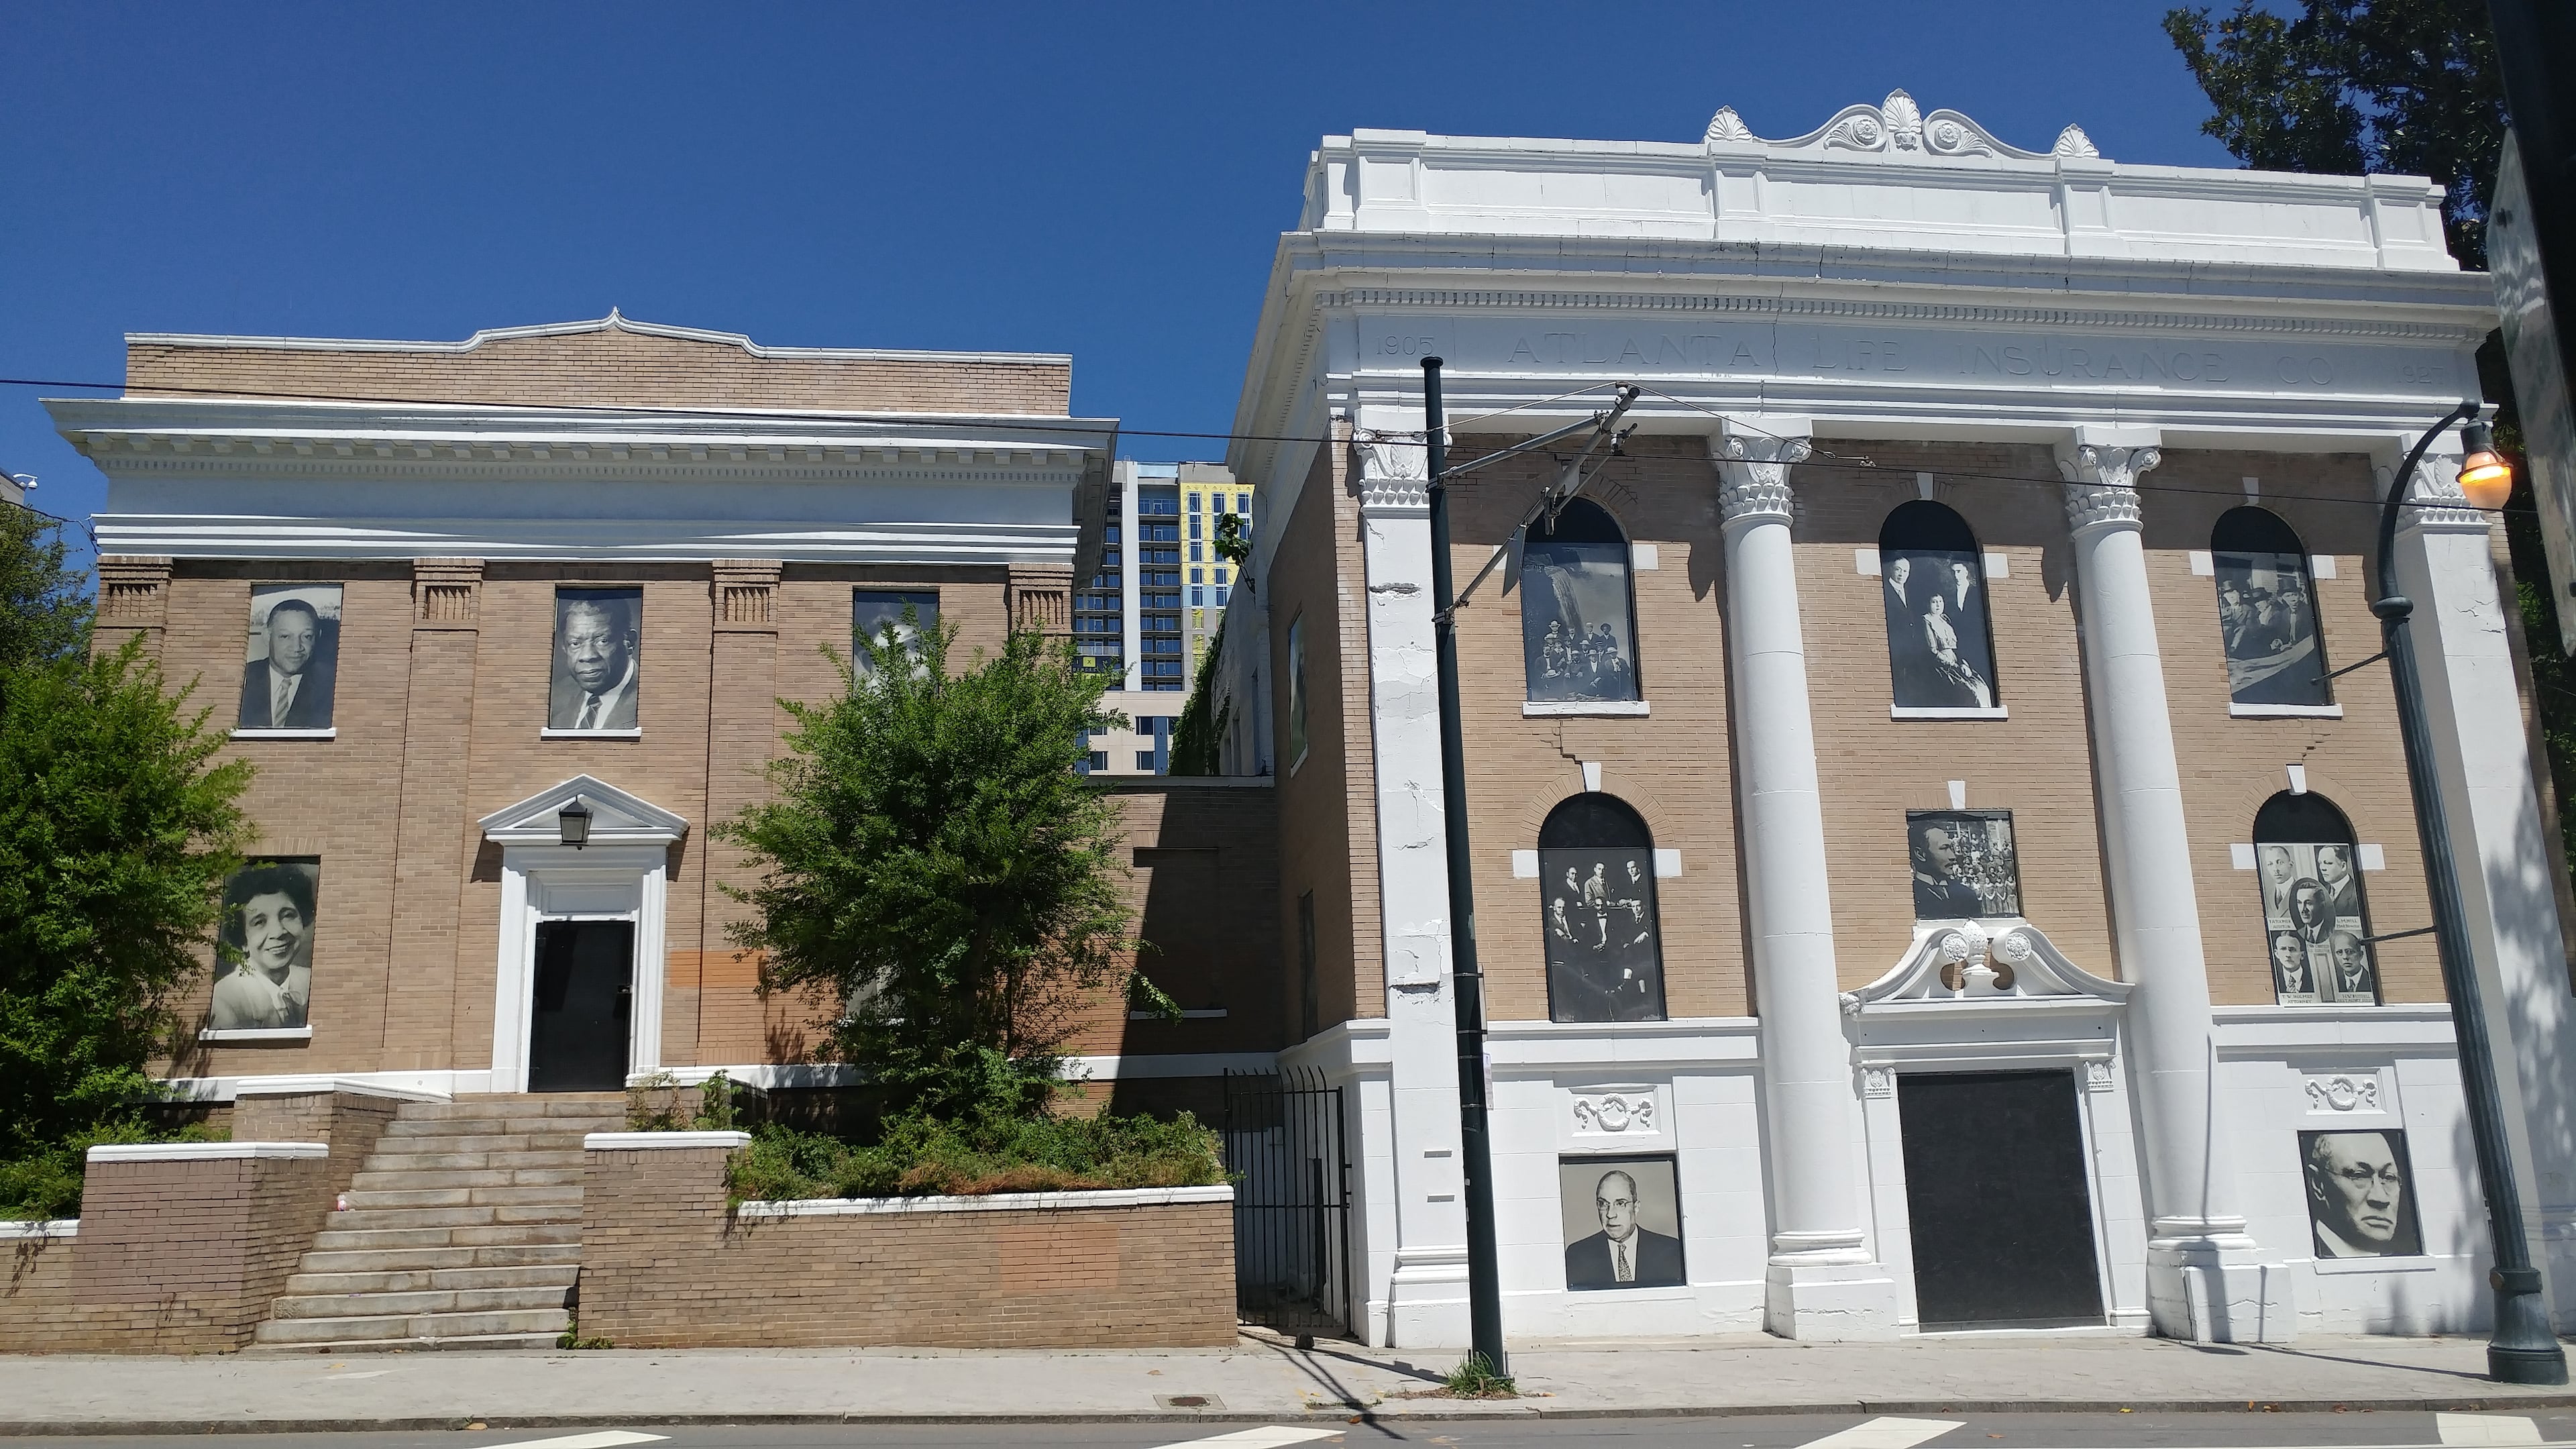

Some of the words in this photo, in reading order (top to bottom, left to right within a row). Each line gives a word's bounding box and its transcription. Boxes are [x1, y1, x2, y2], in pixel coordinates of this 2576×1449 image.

[1375, 335, 1435, 356] 1905
[1506, 333, 1761, 367] ATLANTA
[1811, 337, 1910, 372] LIFE
[1957, 343, 2229, 383] INSURANCE
[2276, 355, 2334, 386] CO
